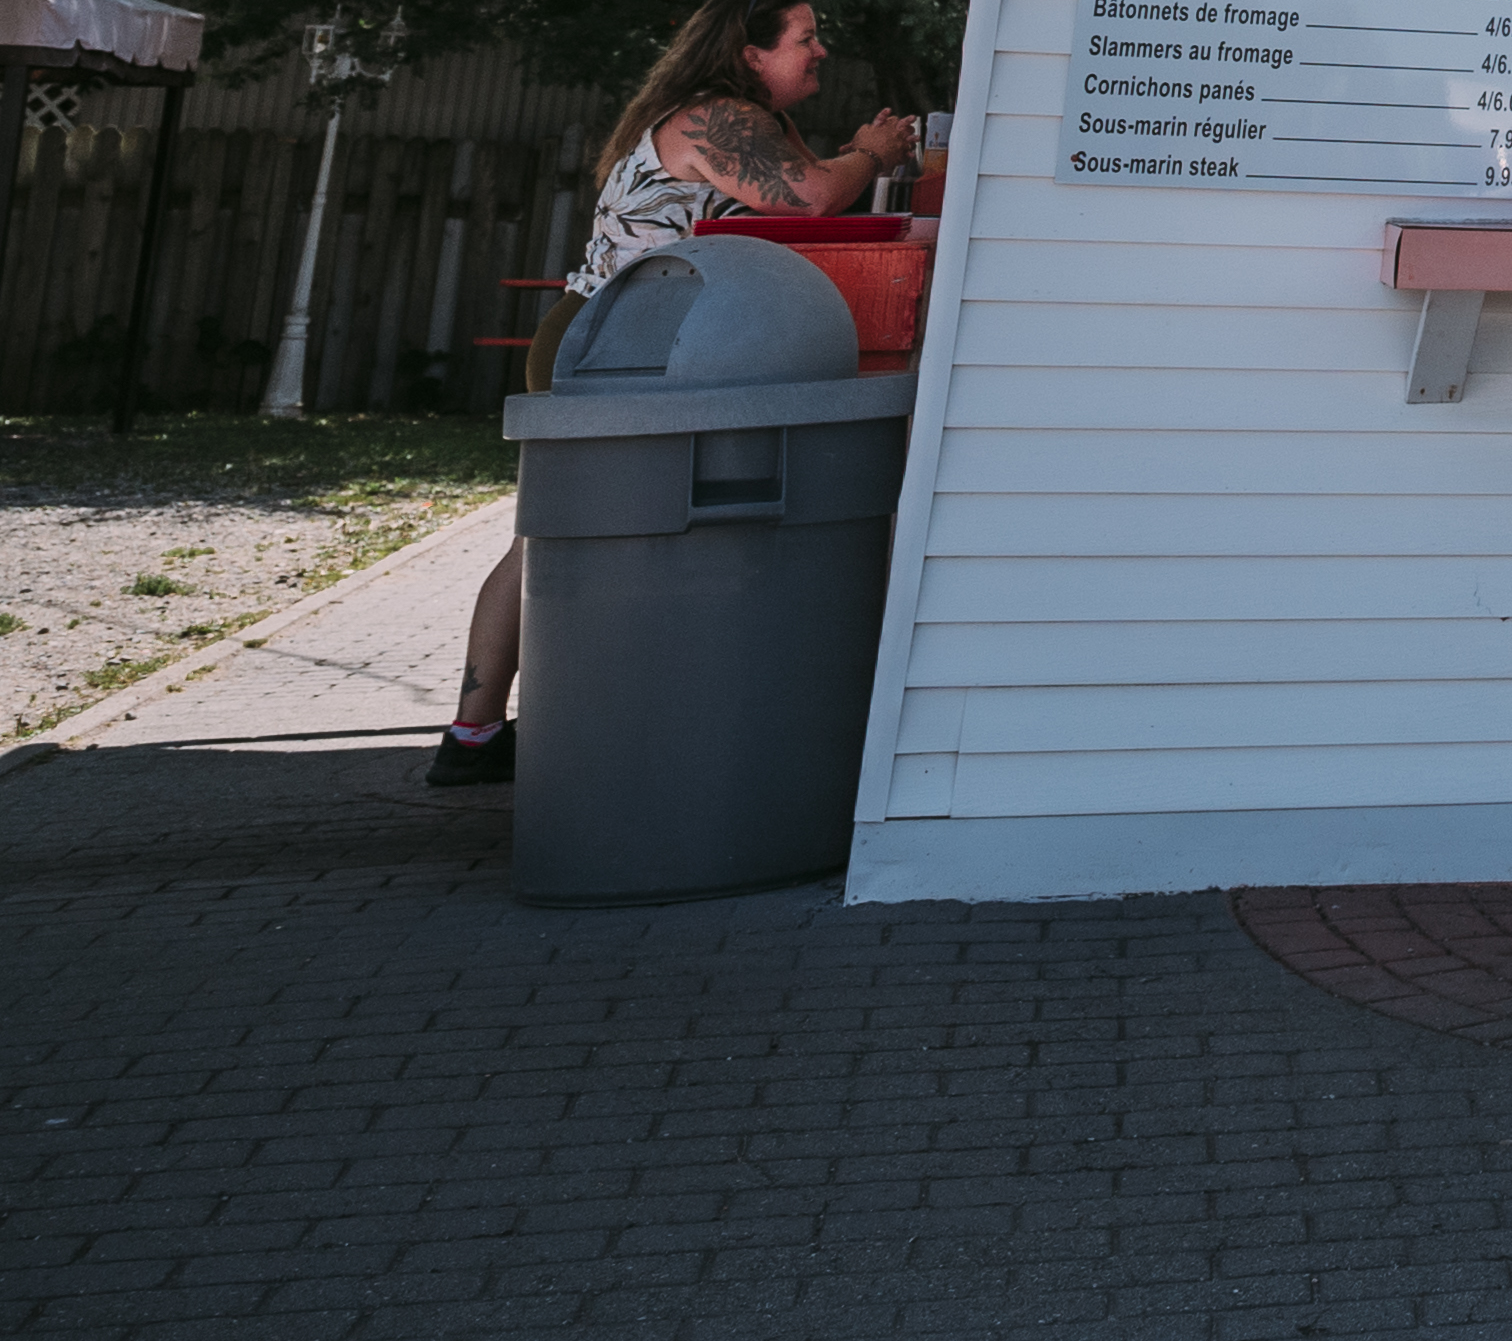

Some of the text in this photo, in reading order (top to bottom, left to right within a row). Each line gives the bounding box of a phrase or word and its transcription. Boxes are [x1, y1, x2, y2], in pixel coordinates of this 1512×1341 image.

[1196, 2, 1217, 23] de
[1225, 3, 1299, 31] fromage
[1084, 74, 1192, 98] Cornichons
[1199, 80, 1254, 104] panés
[1079, 112, 1187, 136] Sous-marin
[1194, 117, 1266, 143] régulier
[1073, 151, 1182, 175] Sous-marin
[1189, 157, 1239, 177] steak
